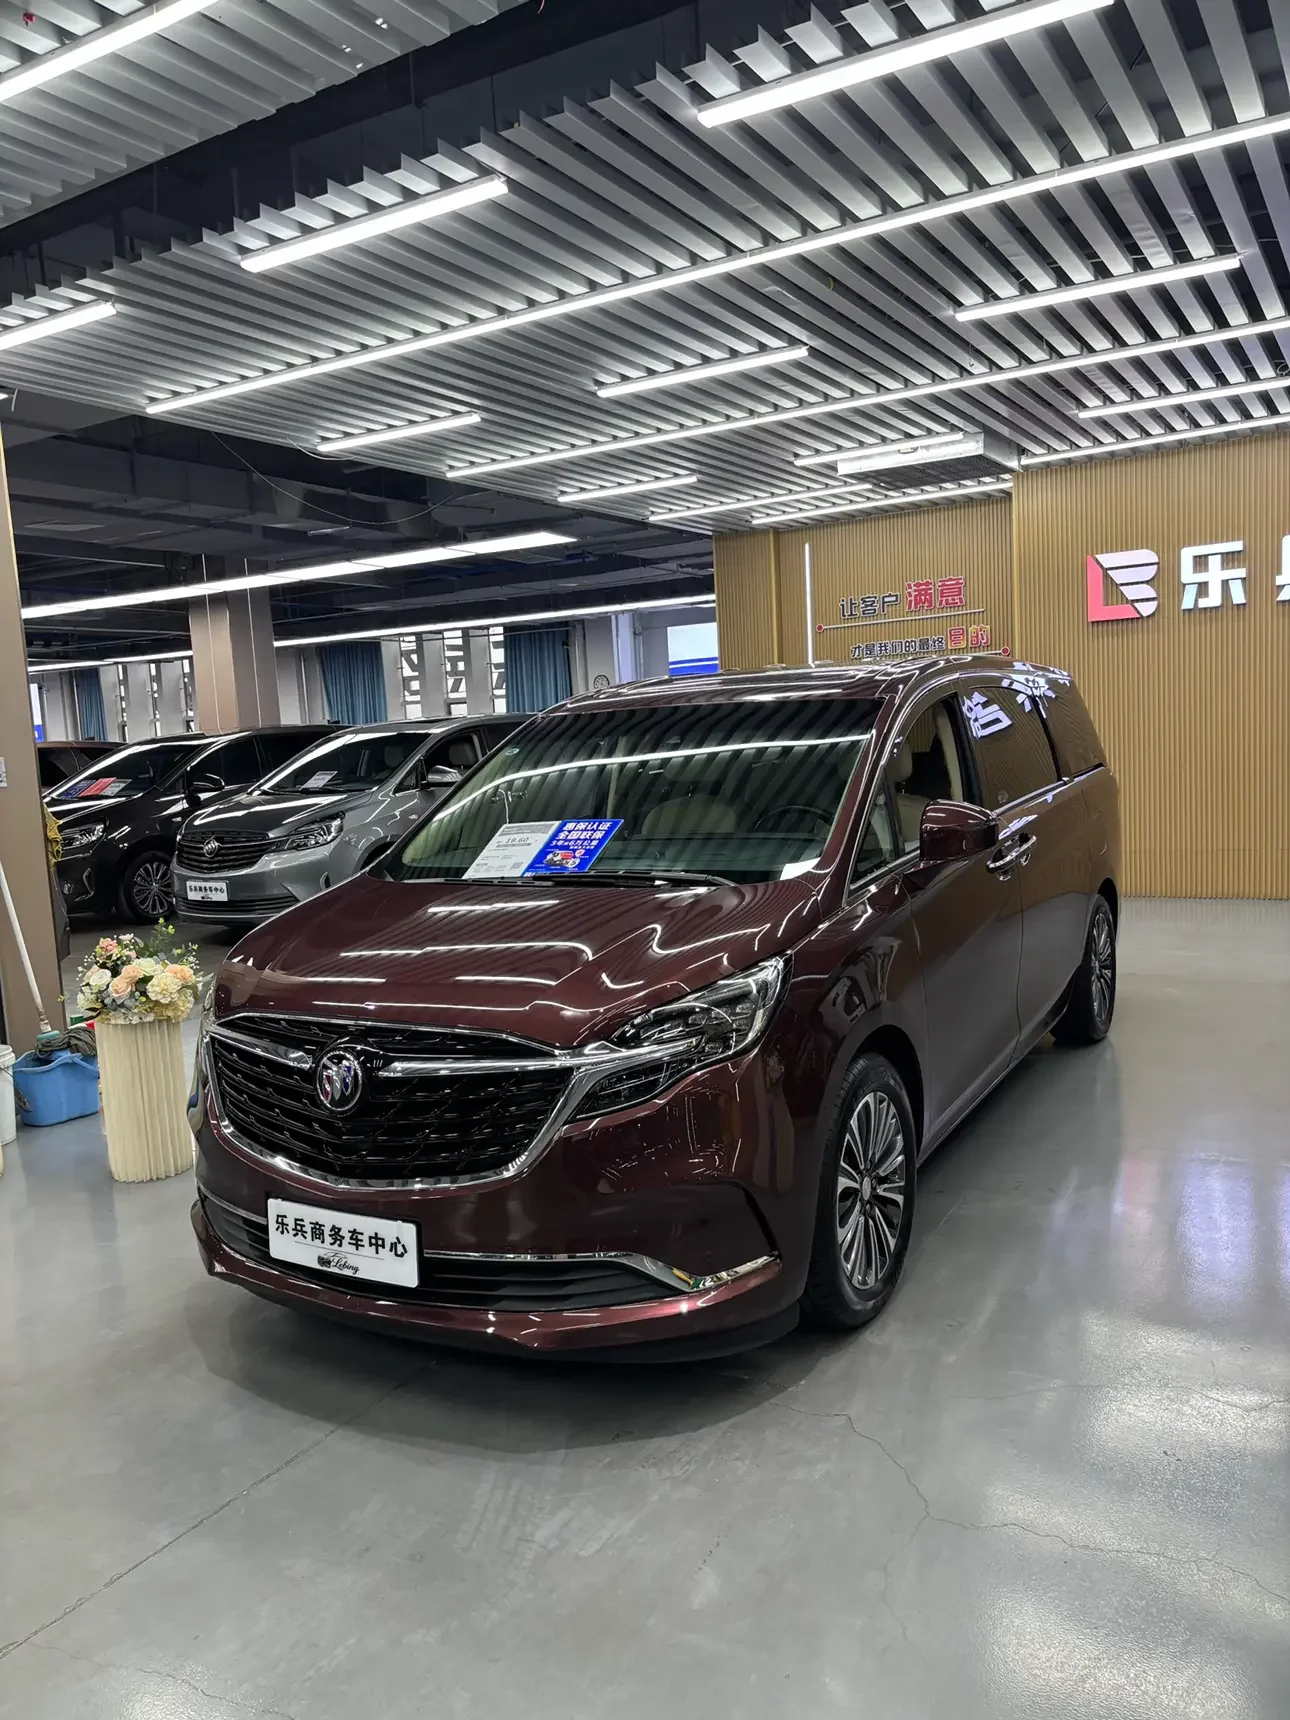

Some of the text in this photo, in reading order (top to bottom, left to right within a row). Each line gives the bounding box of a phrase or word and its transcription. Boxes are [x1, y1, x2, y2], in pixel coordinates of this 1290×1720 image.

[1180, 534, 1290, 610] 乐
[839, 575, 966, 619] 让客户满意
[851, 625, 990, 658] 才是我们的最终目的
[555, 831, 606, 839] 全国联保
[275, 1213, 408, 1258] 乐兵商务车中心
[331, 1257, 360, 1275] Lebing
